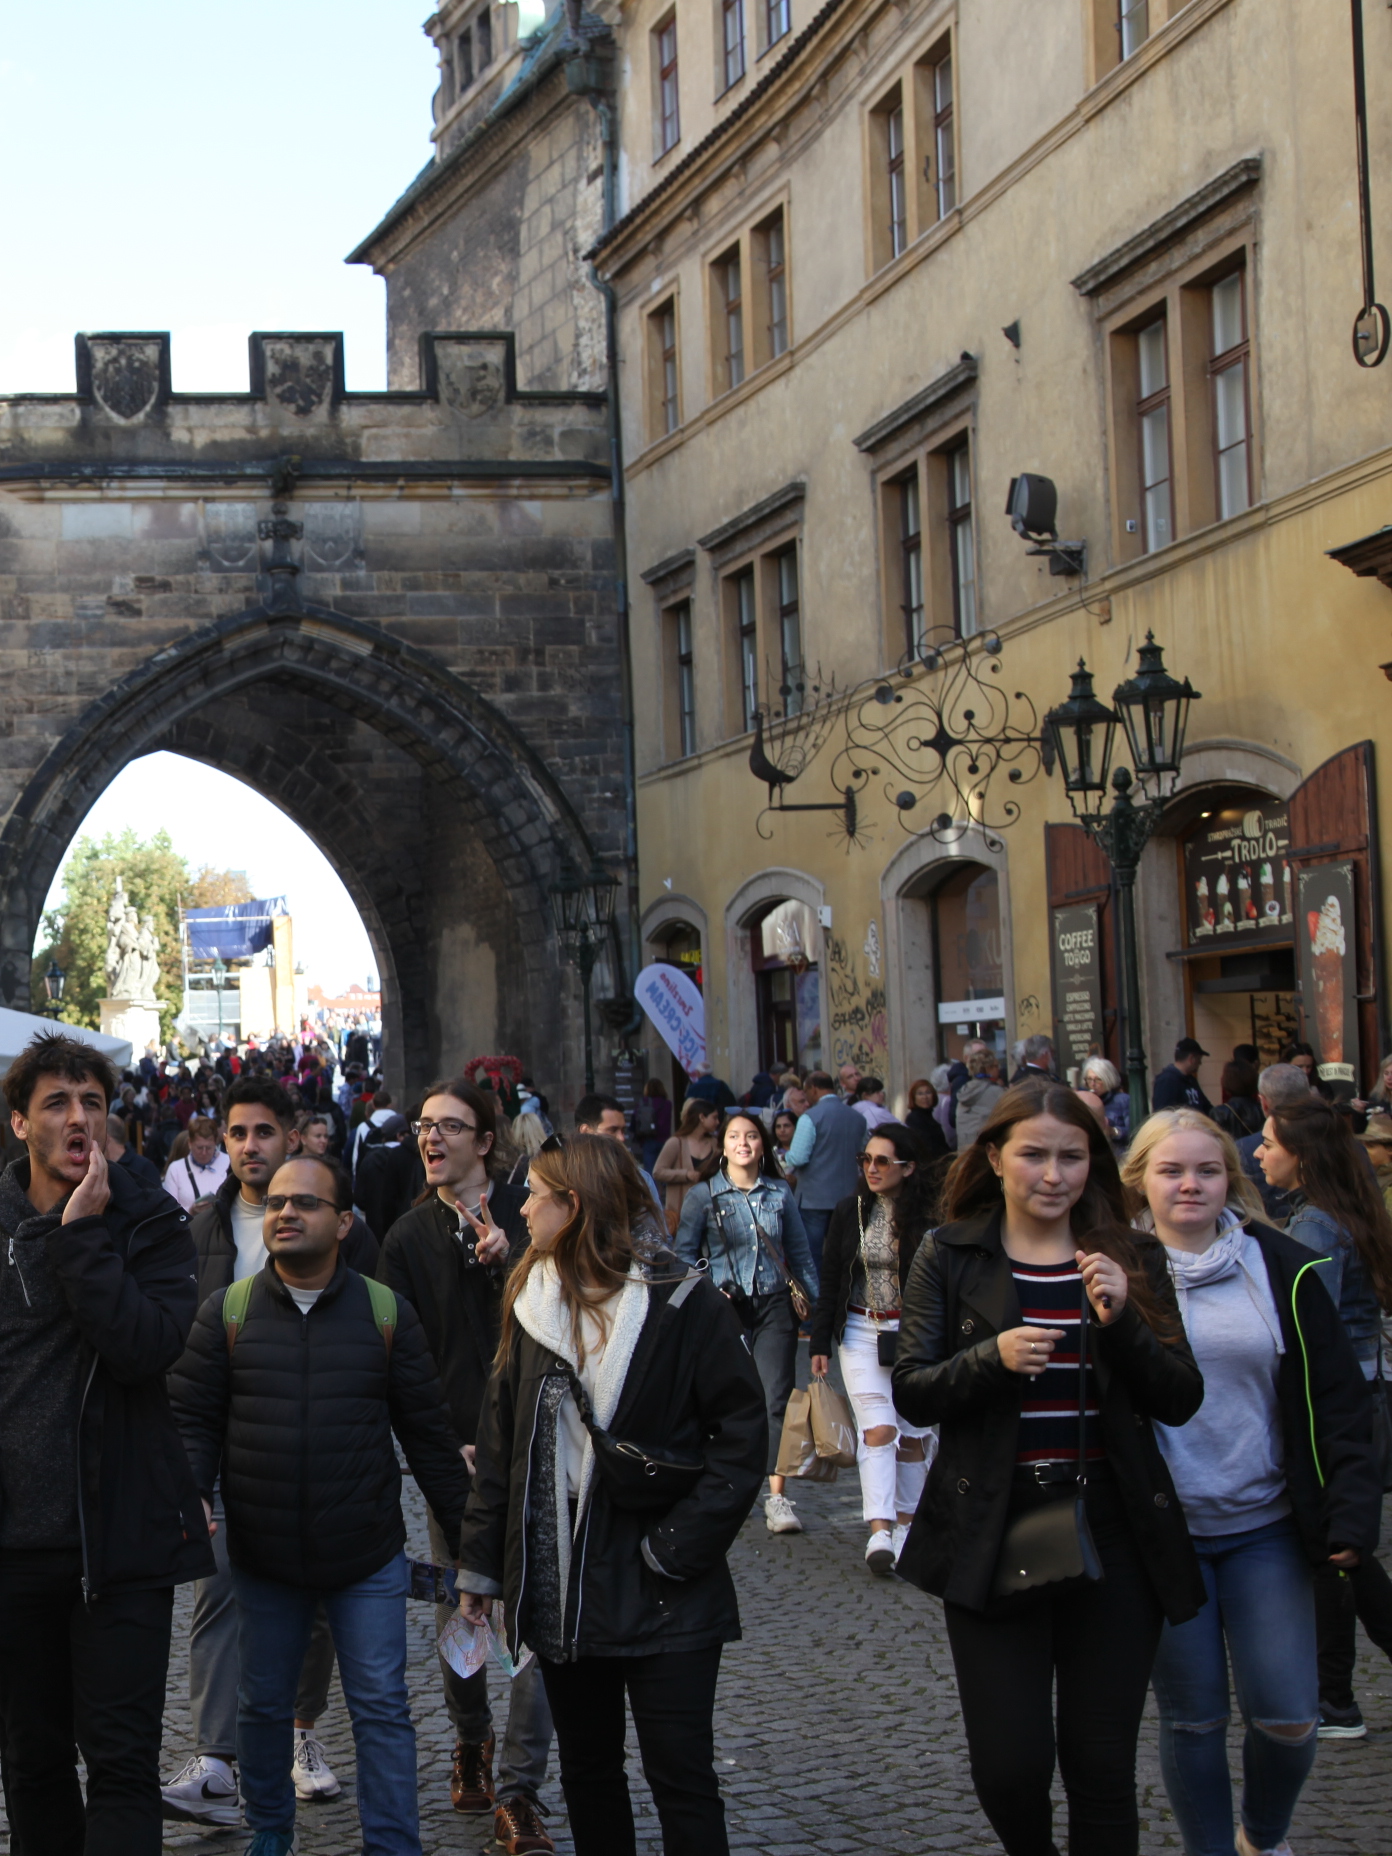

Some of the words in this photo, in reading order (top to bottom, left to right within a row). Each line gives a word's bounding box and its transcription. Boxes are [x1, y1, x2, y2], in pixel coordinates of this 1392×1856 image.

[1264, 813, 1289, 830] TRADIČ
[1230, 831, 1277, 863] TRDLO
[1059, 929, 1094, 951] COFFEE
[1064, 952, 1074, 966] TO
[1080, 951, 1090, 965] GO
